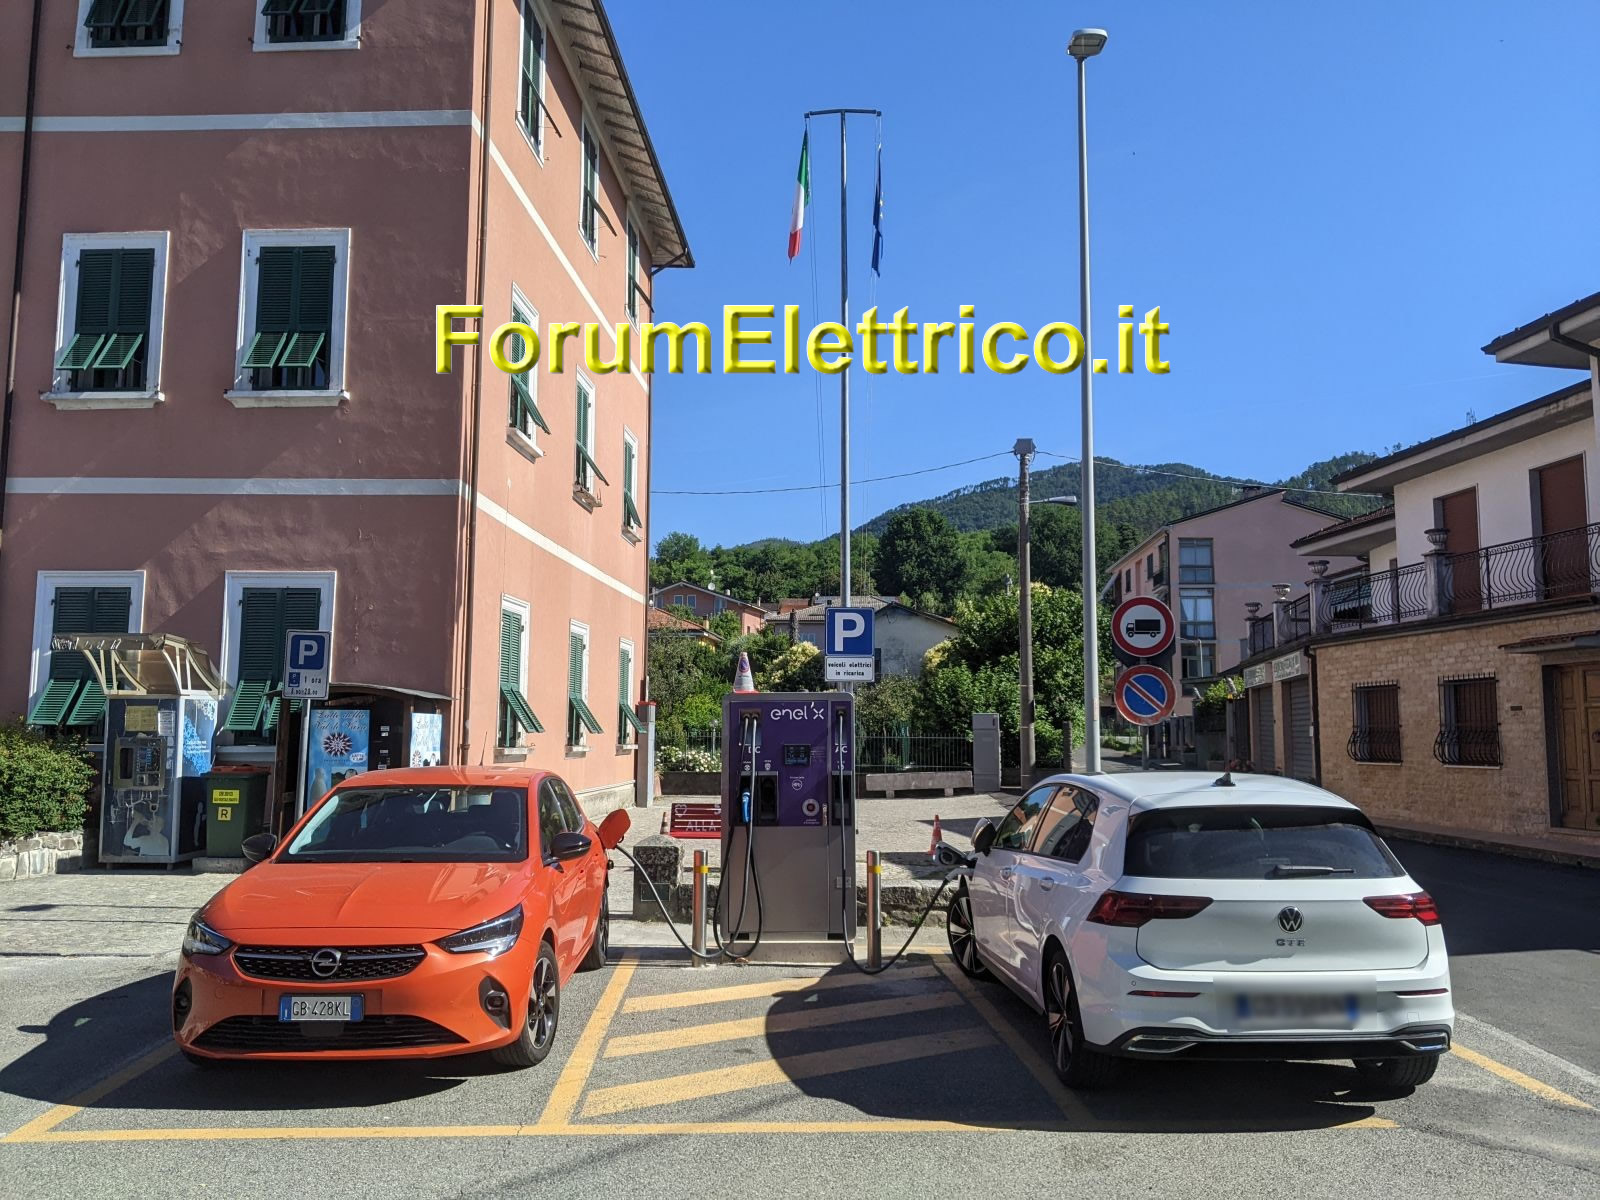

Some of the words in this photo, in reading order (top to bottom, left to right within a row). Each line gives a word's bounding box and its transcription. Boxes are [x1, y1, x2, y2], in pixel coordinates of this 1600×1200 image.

[834, 612, 865, 652] P
[298, 639, 318, 665] P
[770, 705, 808, 720] enel
[220, 808, 229, 819] R
[686, 820, 717, 832] ALLA
